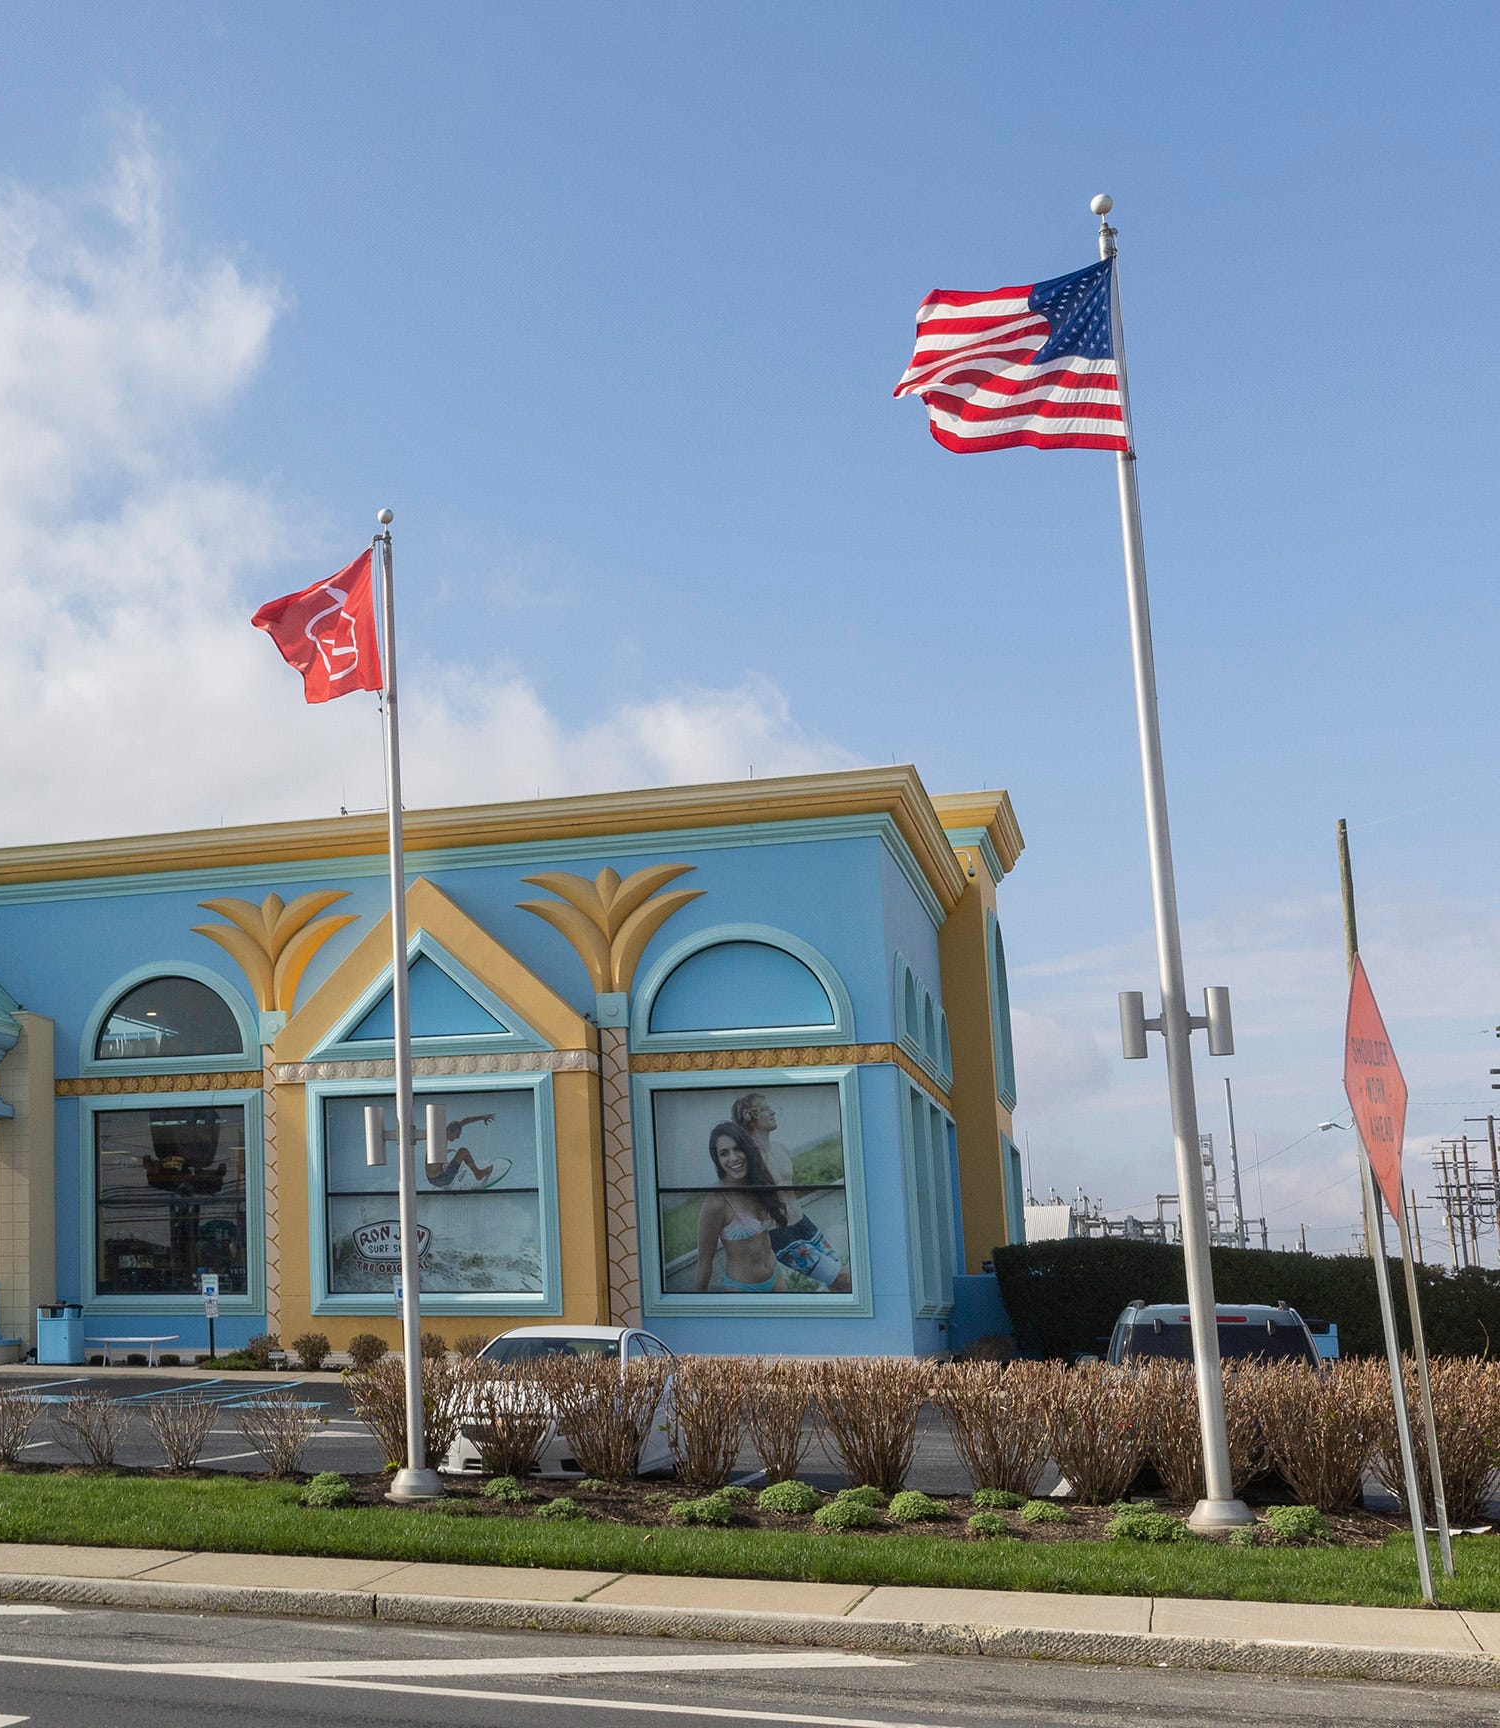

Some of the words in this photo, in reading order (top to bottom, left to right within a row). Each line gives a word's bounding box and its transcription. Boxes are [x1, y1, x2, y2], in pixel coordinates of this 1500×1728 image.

[1351, 1036, 1389, 1067] SHOULDER
[1365, 1077, 1387, 1105] WORK
[1369, 1115, 1394, 1143] AHEAD
[359, 1225, 390, 1247] RON
[368, 1244, 389, 1254] SURF
